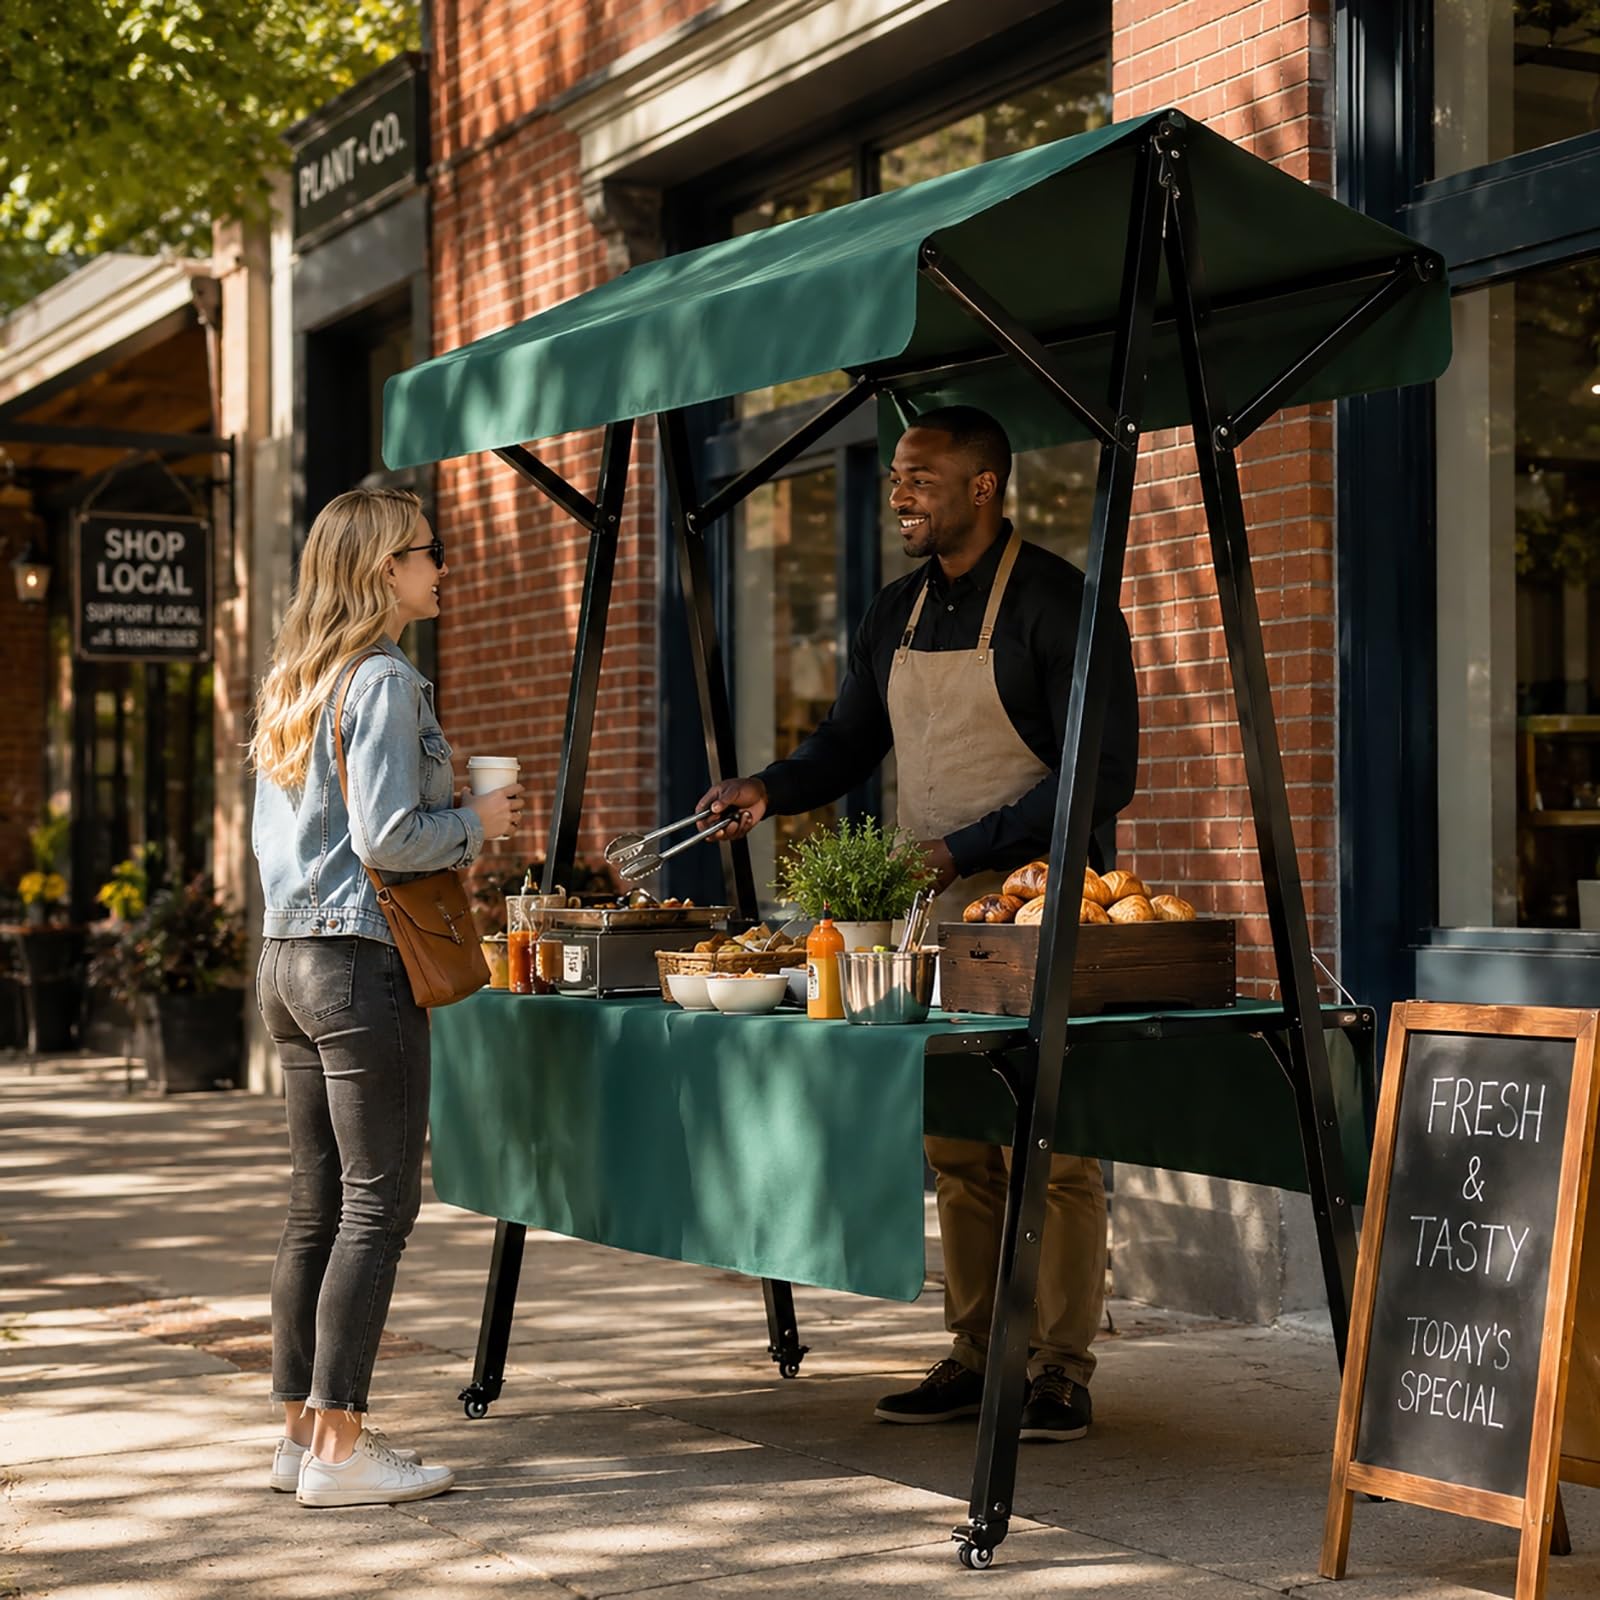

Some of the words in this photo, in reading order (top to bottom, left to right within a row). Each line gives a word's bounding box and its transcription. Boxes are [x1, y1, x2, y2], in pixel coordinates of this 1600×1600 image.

[104, 528, 186, 561] SHOP
[96, 562, 193, 595] LOCAL
[86, 602, 153, 623] SUPPORT
[155, 605, 202, 625] LOCAL
[1427, 1077, 1546, 1142] FRESH
[1462, 1156, 1485, 1202] &
[1410, 1215, 1530, 1282] TASTY
[1407, 1317, 1511, 1370] TODAY'S
[1398, 1370, 1504, 1428] SPECIAL
